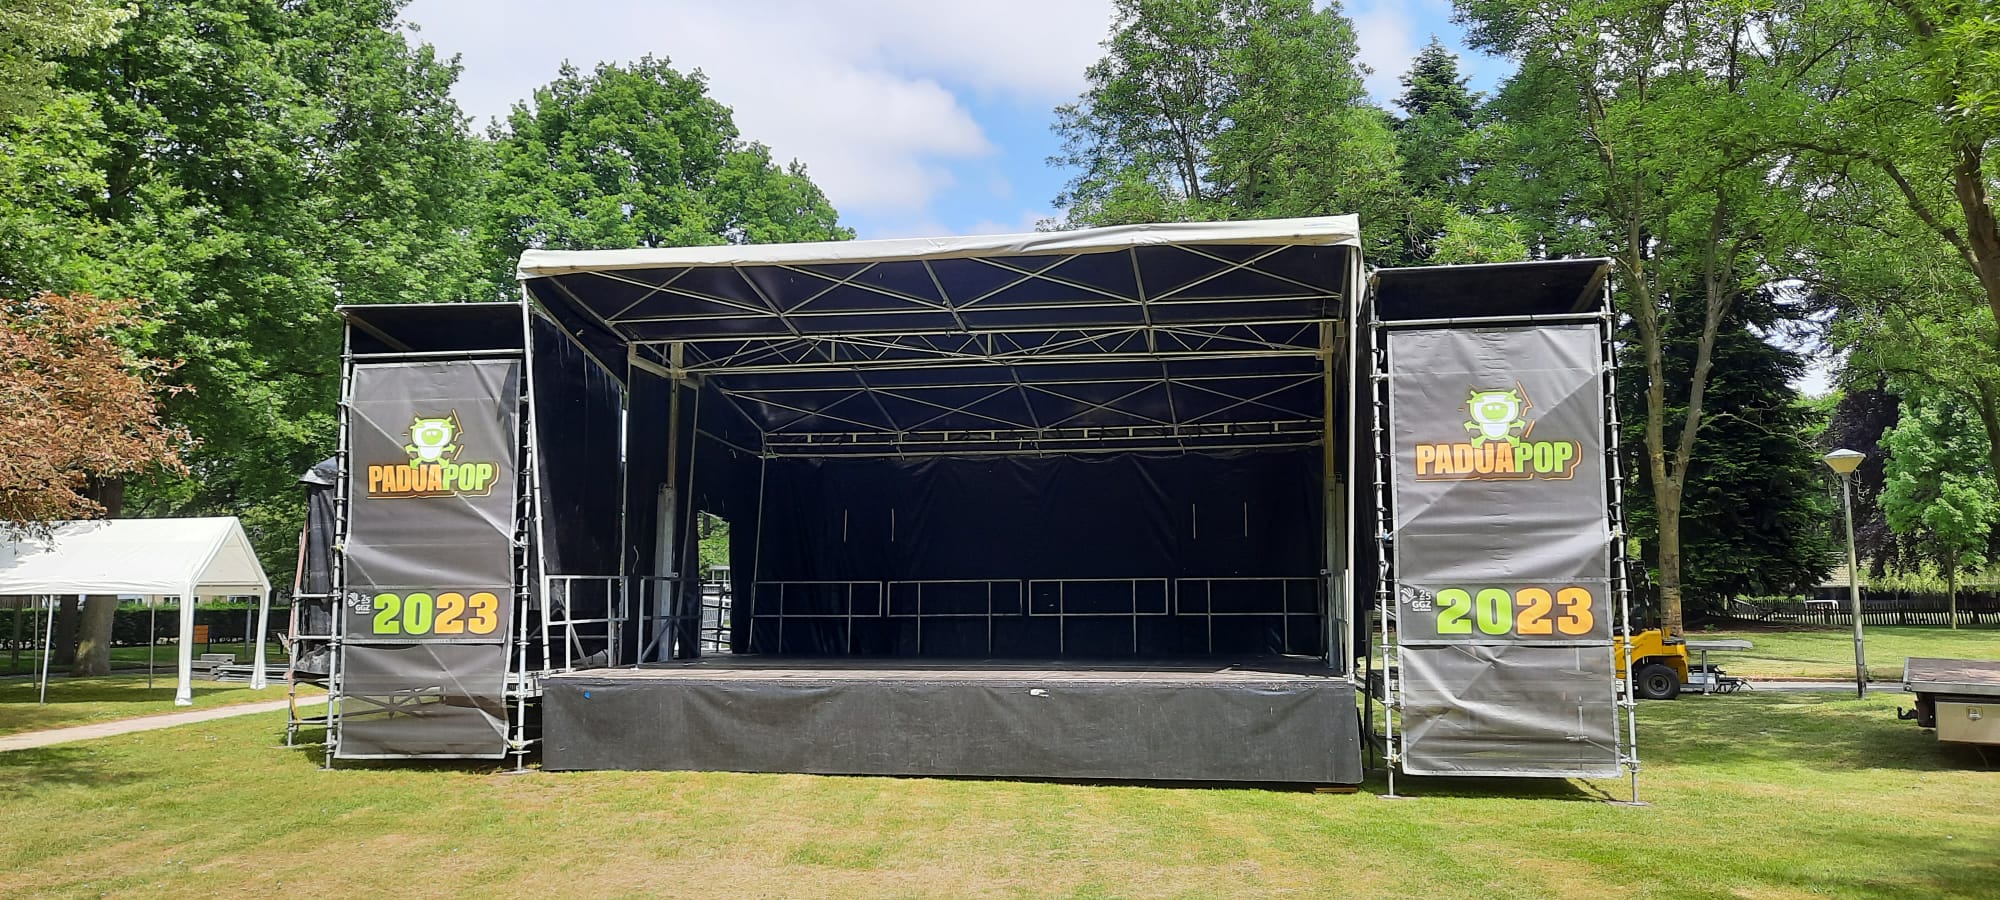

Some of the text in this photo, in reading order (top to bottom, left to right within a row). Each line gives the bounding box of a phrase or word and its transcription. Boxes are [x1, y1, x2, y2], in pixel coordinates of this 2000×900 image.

[1416, 442, 1573, 475] PADUAPOP
[368, 463, 493, 493] PADUAPOP
[373, 592, 498, 635] 2023
[1412, 600, 1431, 608] GGZ
[1436, 587, 1594, 635] 2023
